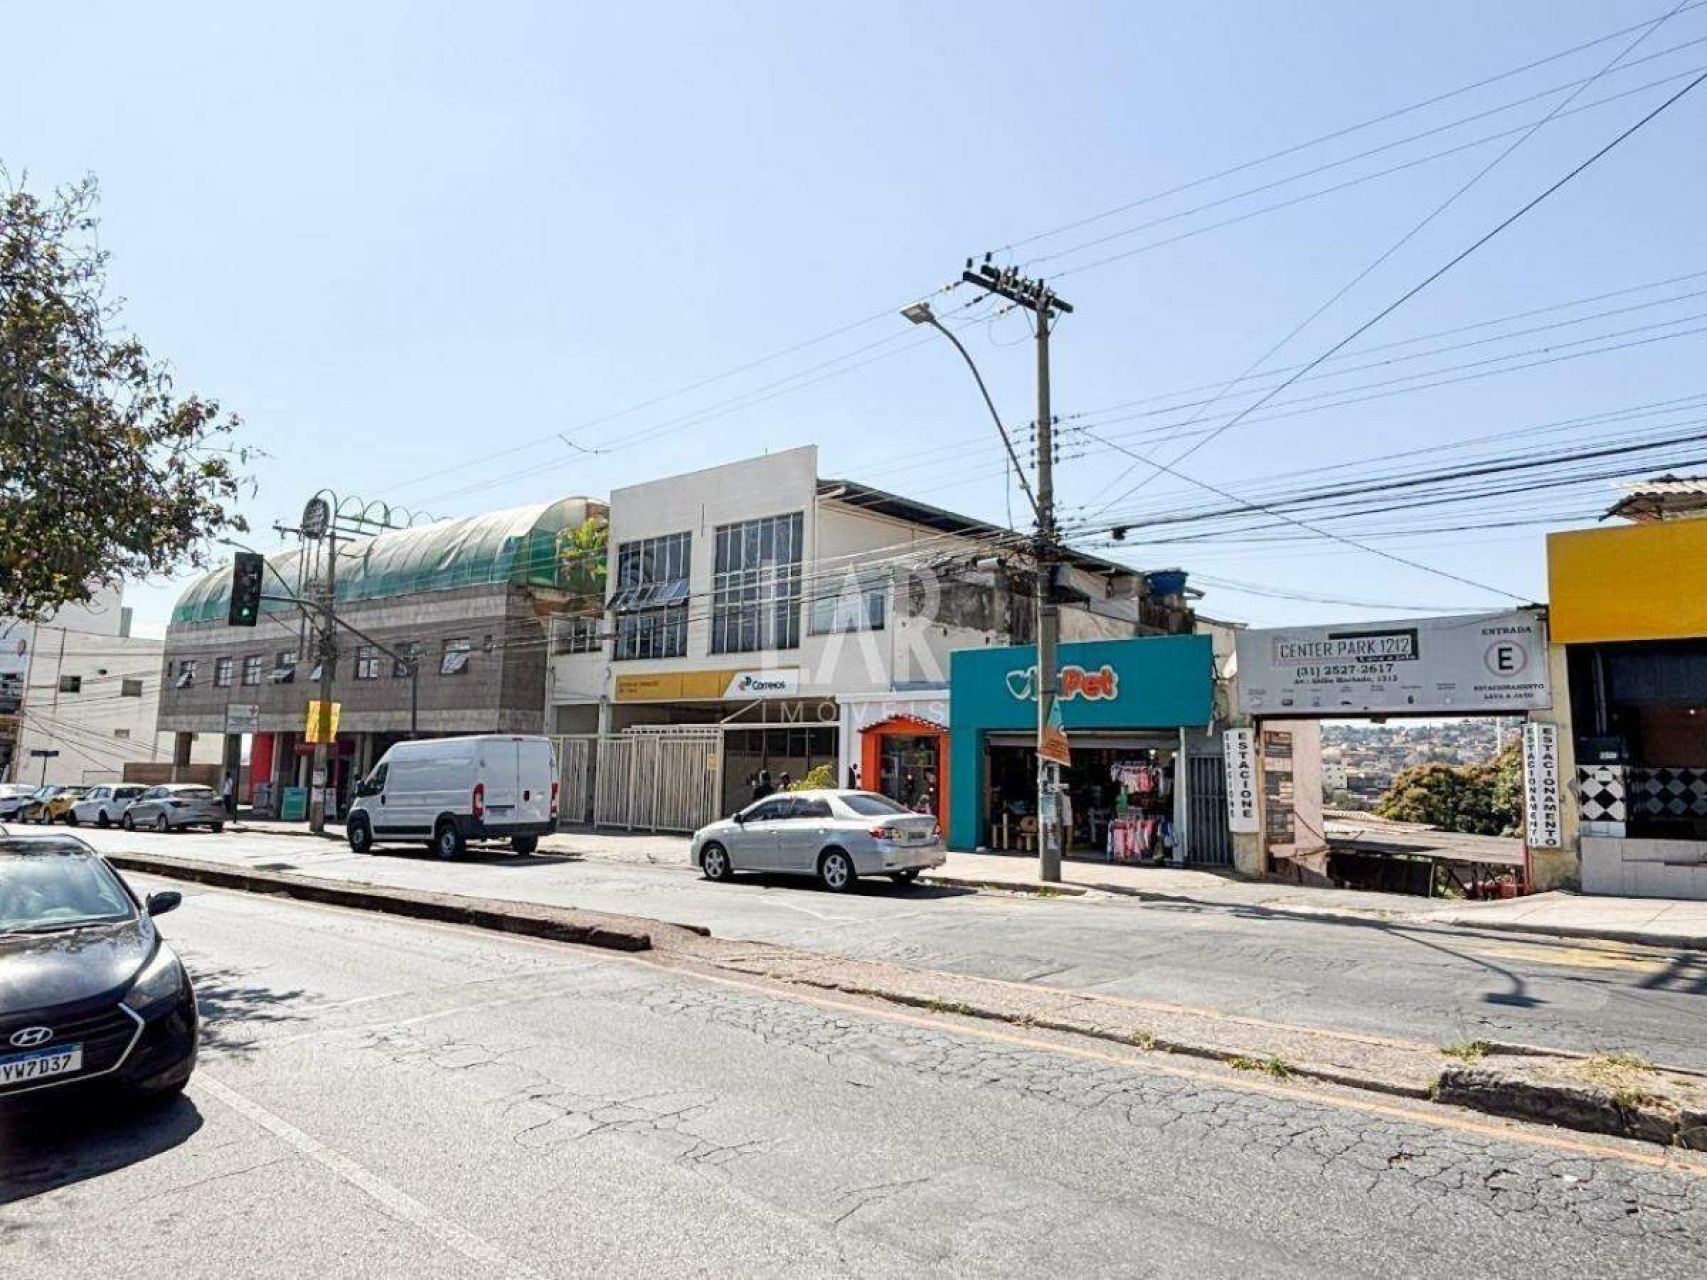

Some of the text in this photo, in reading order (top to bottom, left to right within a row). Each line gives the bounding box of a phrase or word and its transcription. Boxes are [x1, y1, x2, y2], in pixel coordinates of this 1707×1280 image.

[1481, 626, 1533, 635] ENTRADA
[1280, 638, 1409, 658] CENTER PARK 1212
[1497, 647, 1514, 671] E
[752, 680, 786, 691] Correios
[1238, 731, 1253, 819] ESTACIONE
[1543, 727, 1557, 846] ESTACIONAMENTO
[0, 1053, 71, 1081] YW7D37
